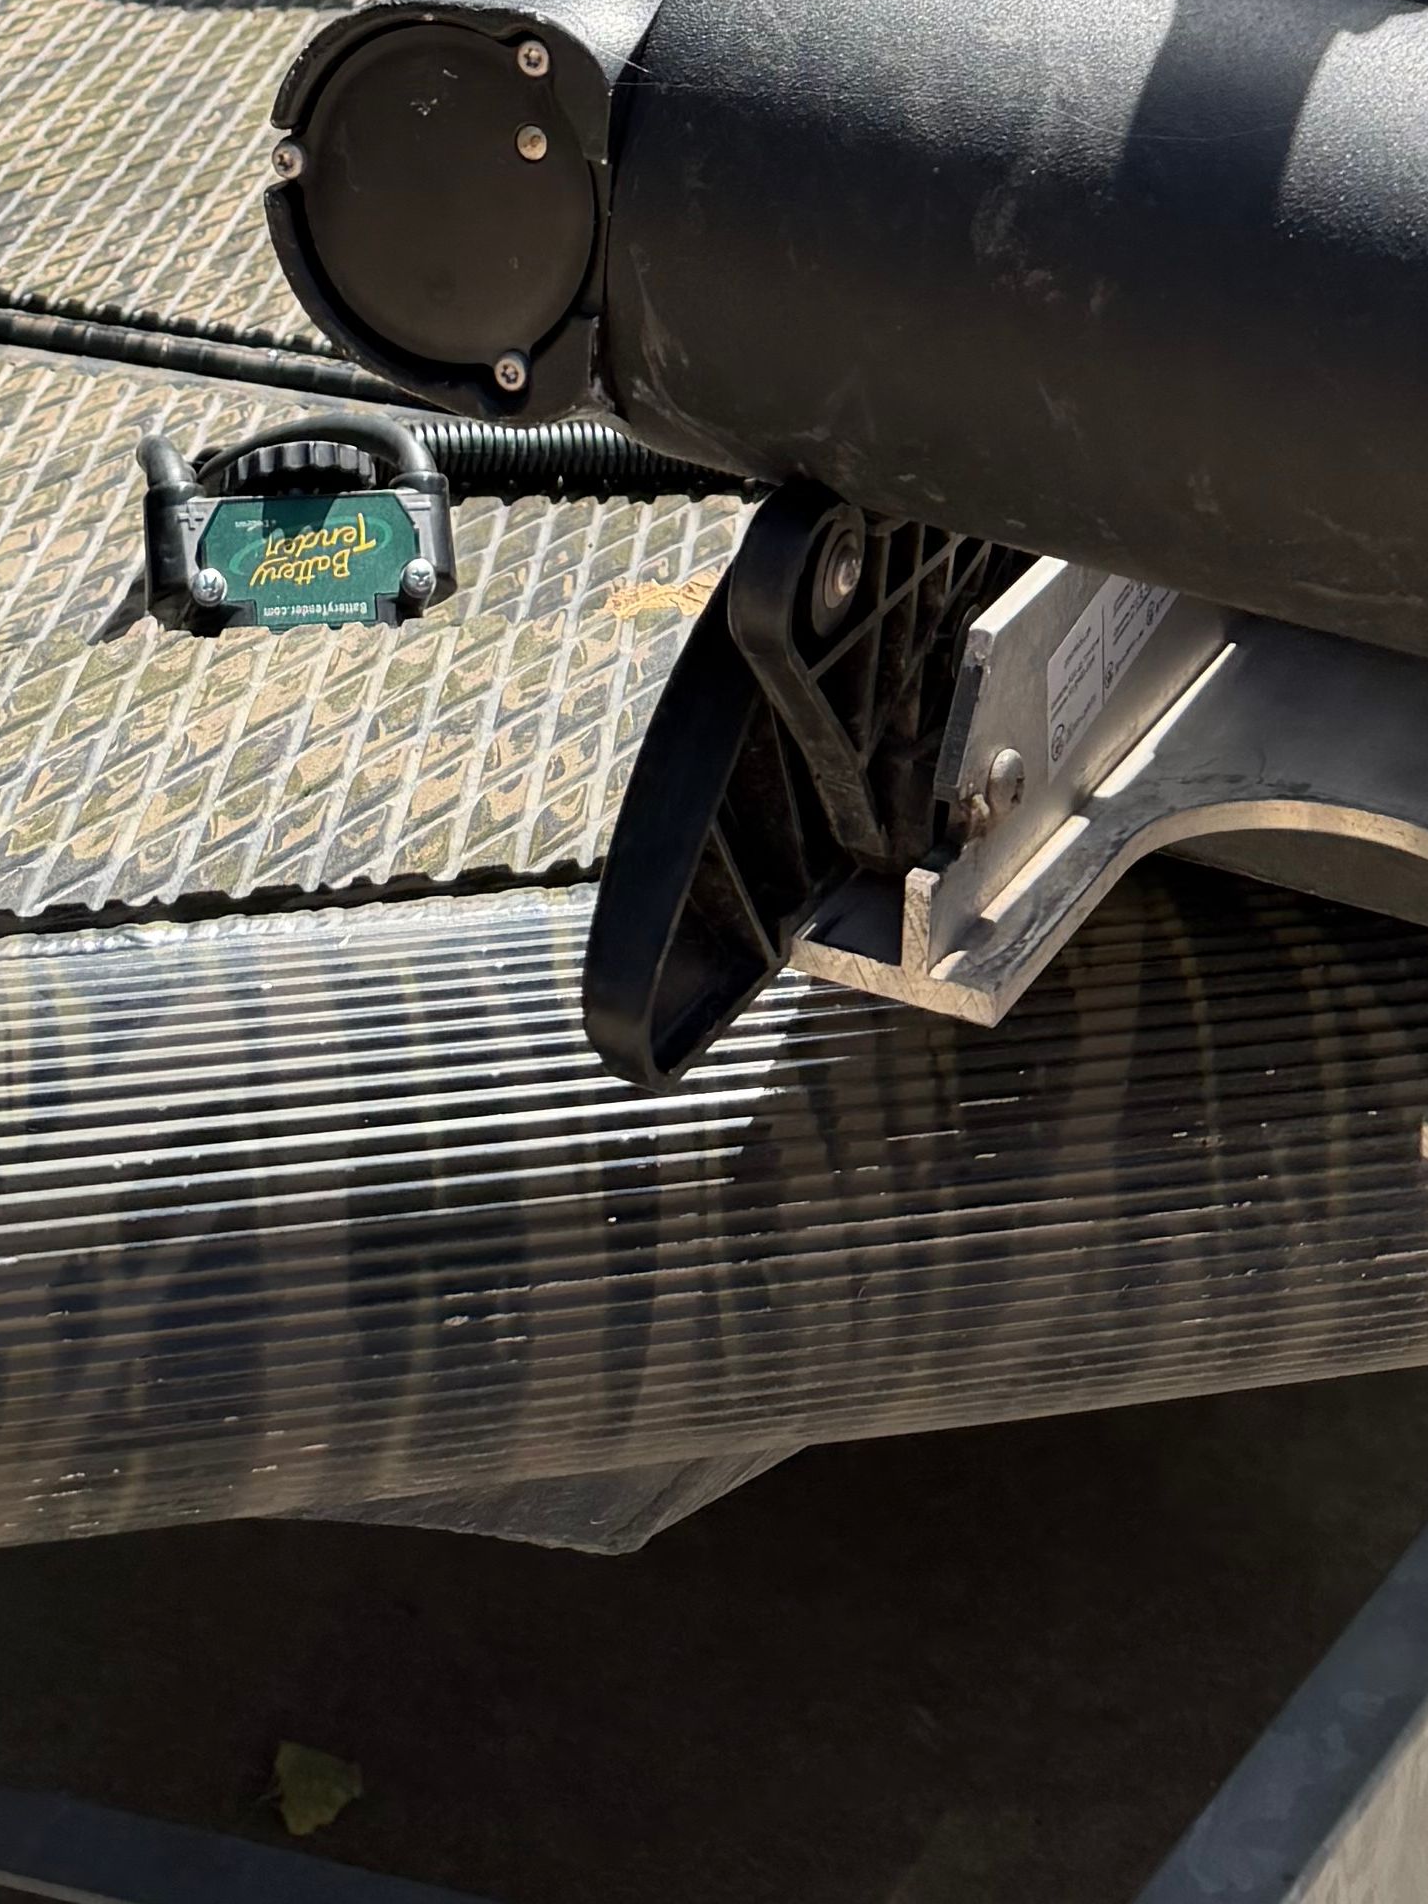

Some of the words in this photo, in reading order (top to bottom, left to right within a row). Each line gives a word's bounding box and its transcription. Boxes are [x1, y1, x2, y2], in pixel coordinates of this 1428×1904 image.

[264, 512, 376, 558] Tender
[249, 548, 351, 587] Battery
[263, 601, 368, 618] BatteryTender.com
